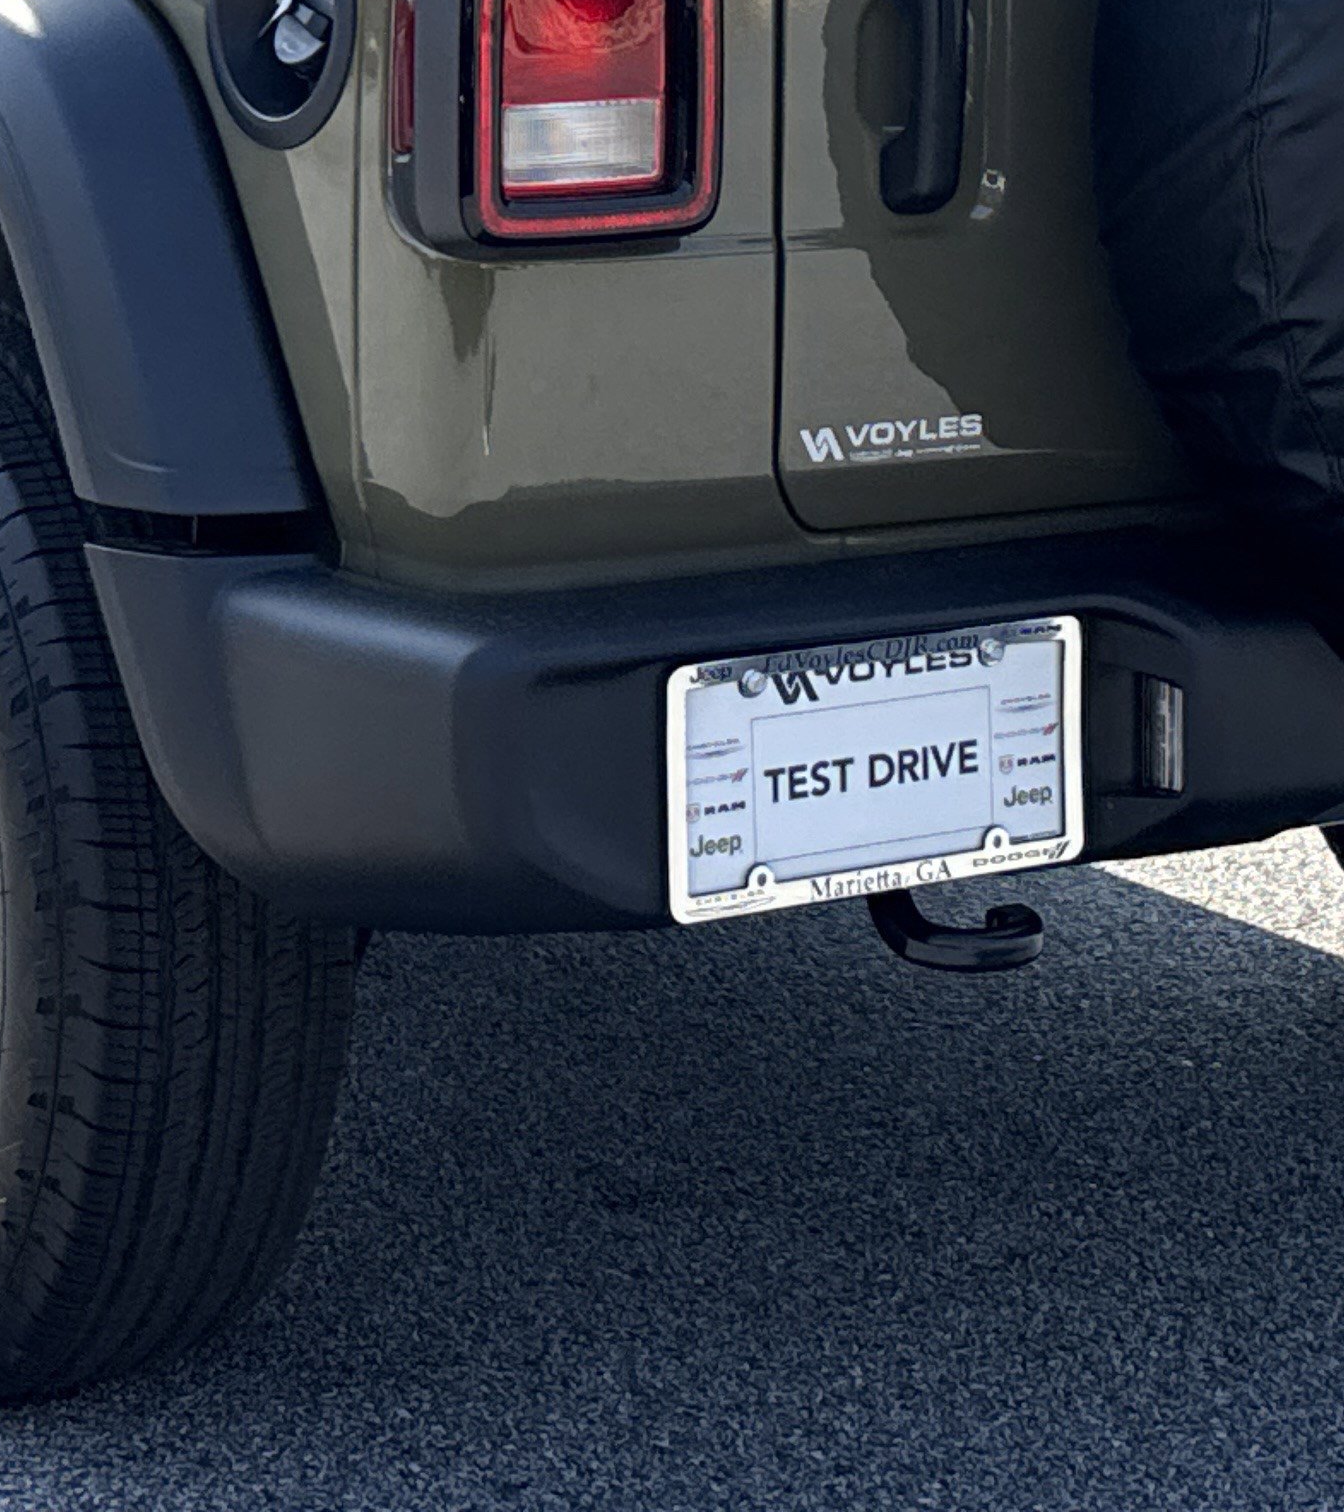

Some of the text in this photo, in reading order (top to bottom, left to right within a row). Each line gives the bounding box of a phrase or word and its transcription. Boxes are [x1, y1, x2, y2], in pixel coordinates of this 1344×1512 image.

[845, 413, 983, 447] VOYLES
[763, 738, 979, 803] TEST DRIVE
[1017, 753, 1056, 767] RAM
[1003, 785, 1053, 807] Jeep
[689, 834, 743, 858] Jeep
[915, 858, 952, 883] GA
